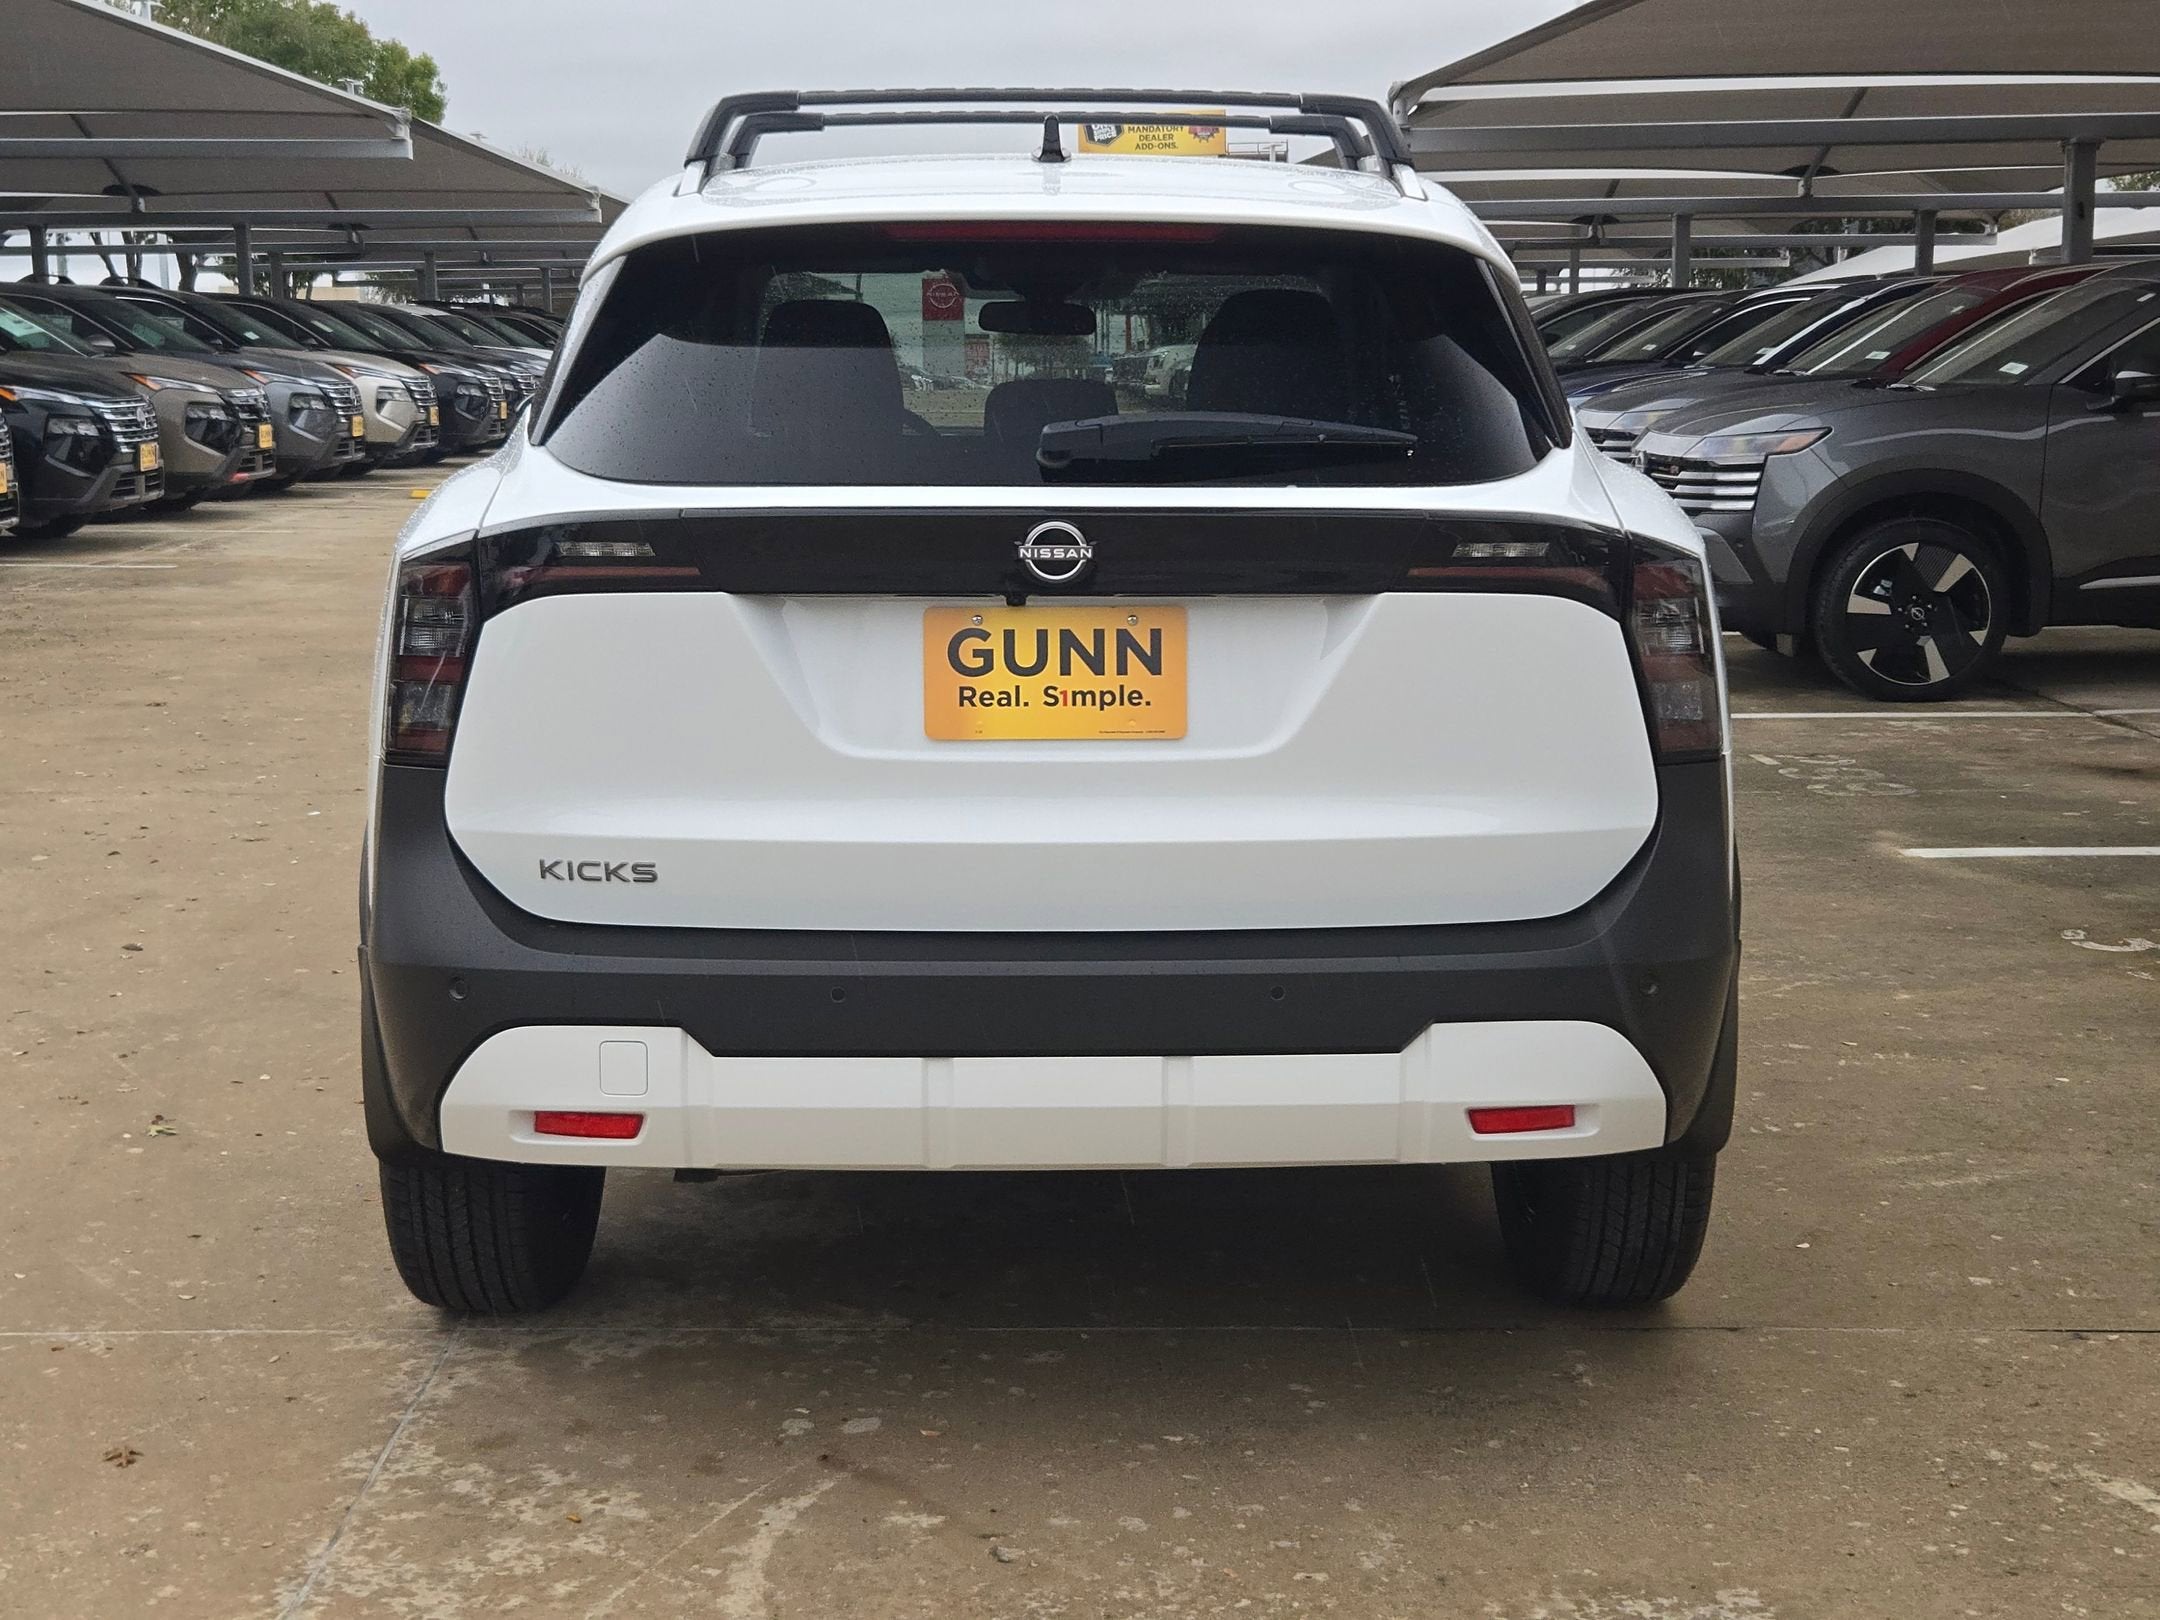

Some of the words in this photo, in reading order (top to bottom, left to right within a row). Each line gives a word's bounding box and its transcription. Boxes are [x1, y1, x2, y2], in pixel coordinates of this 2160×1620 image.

[1128, 125, 1184, 133] MANDATORY
[1139, 133, 1174, 142] DEALER
[1135, 142, 1178, 151] ADD-ONS.
[1020, 548, 1092, 559] NISSAN
[947, 627, 1162, 678] GUNN
[958, 685, 1029, 708] Real.
[539, 858, 659, 883] KICKS
